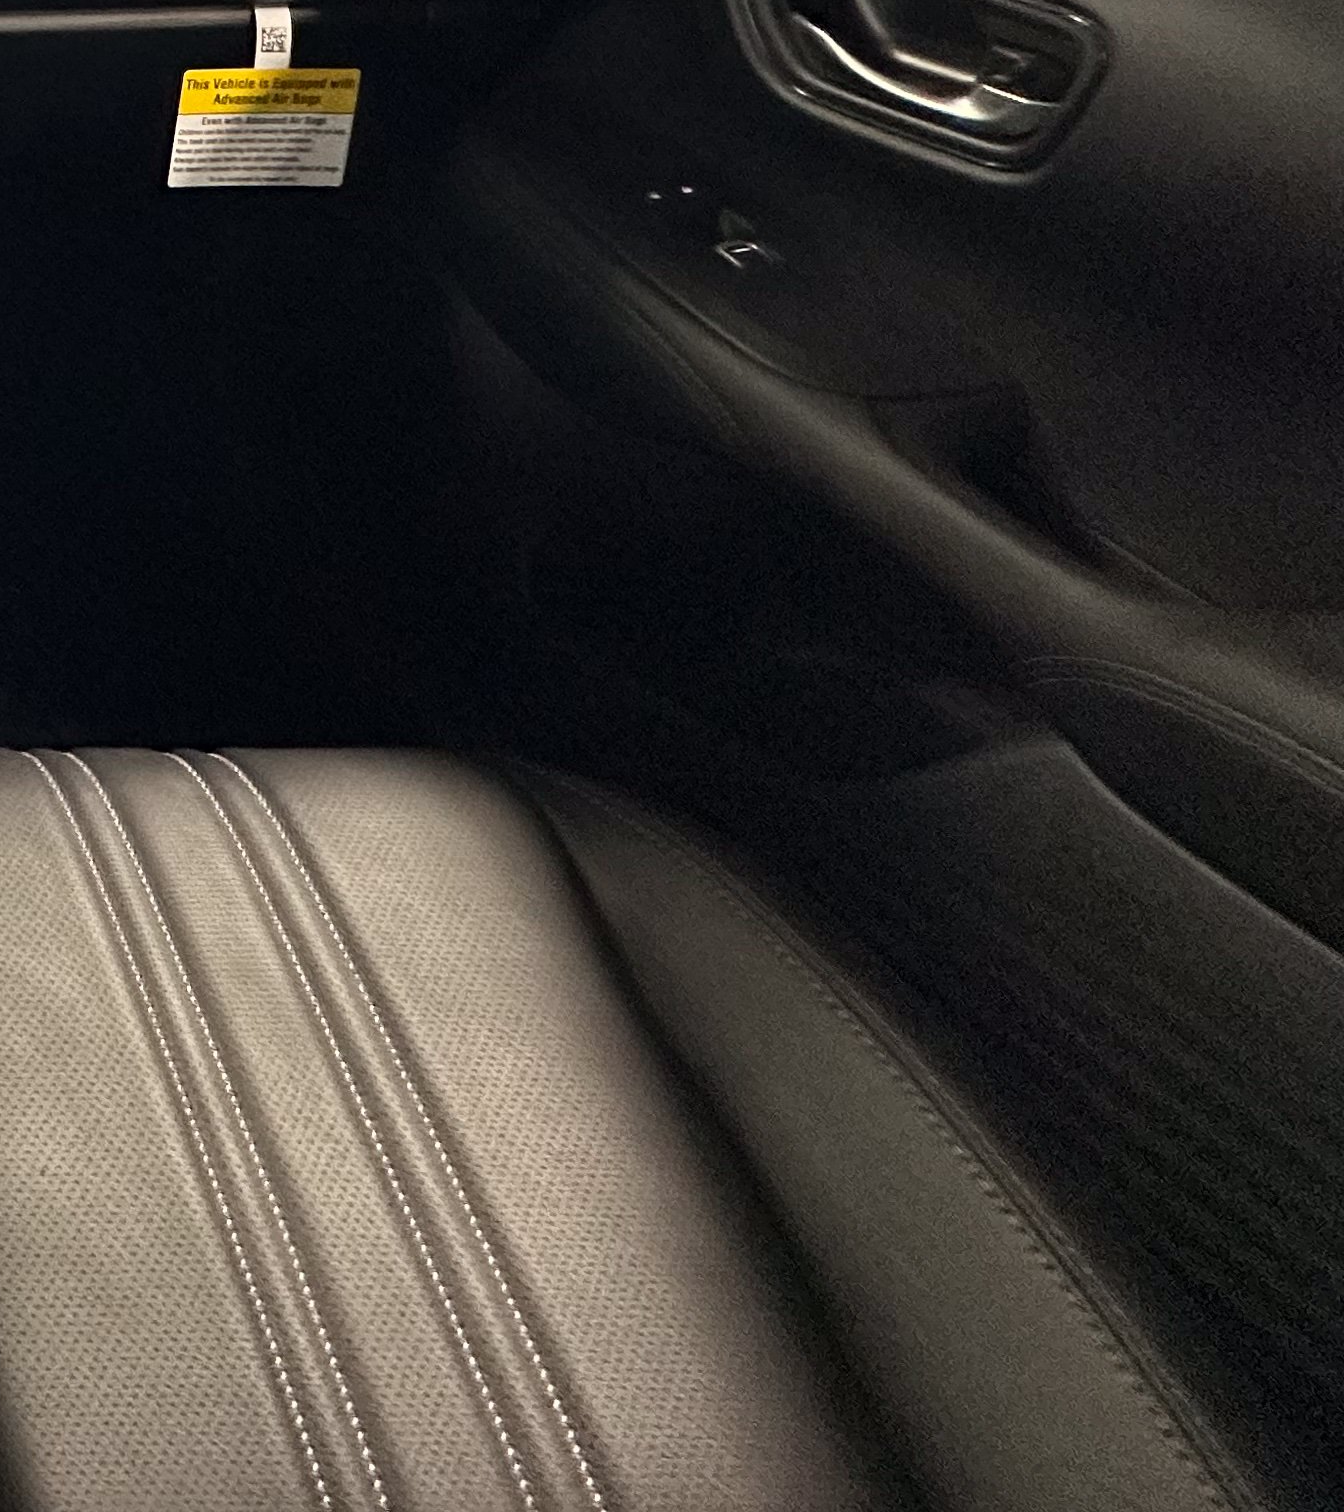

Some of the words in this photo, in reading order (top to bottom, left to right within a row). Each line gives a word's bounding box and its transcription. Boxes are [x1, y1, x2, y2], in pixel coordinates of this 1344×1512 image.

[187, 78, 211, 90] This
[213, 77, 255, 90] Vehicle
[259, 77, 269, 89] is
[330, 77, 356, 89] with
[272, 93, 290, 105] Air
[201, 116, 223, 126] Even
